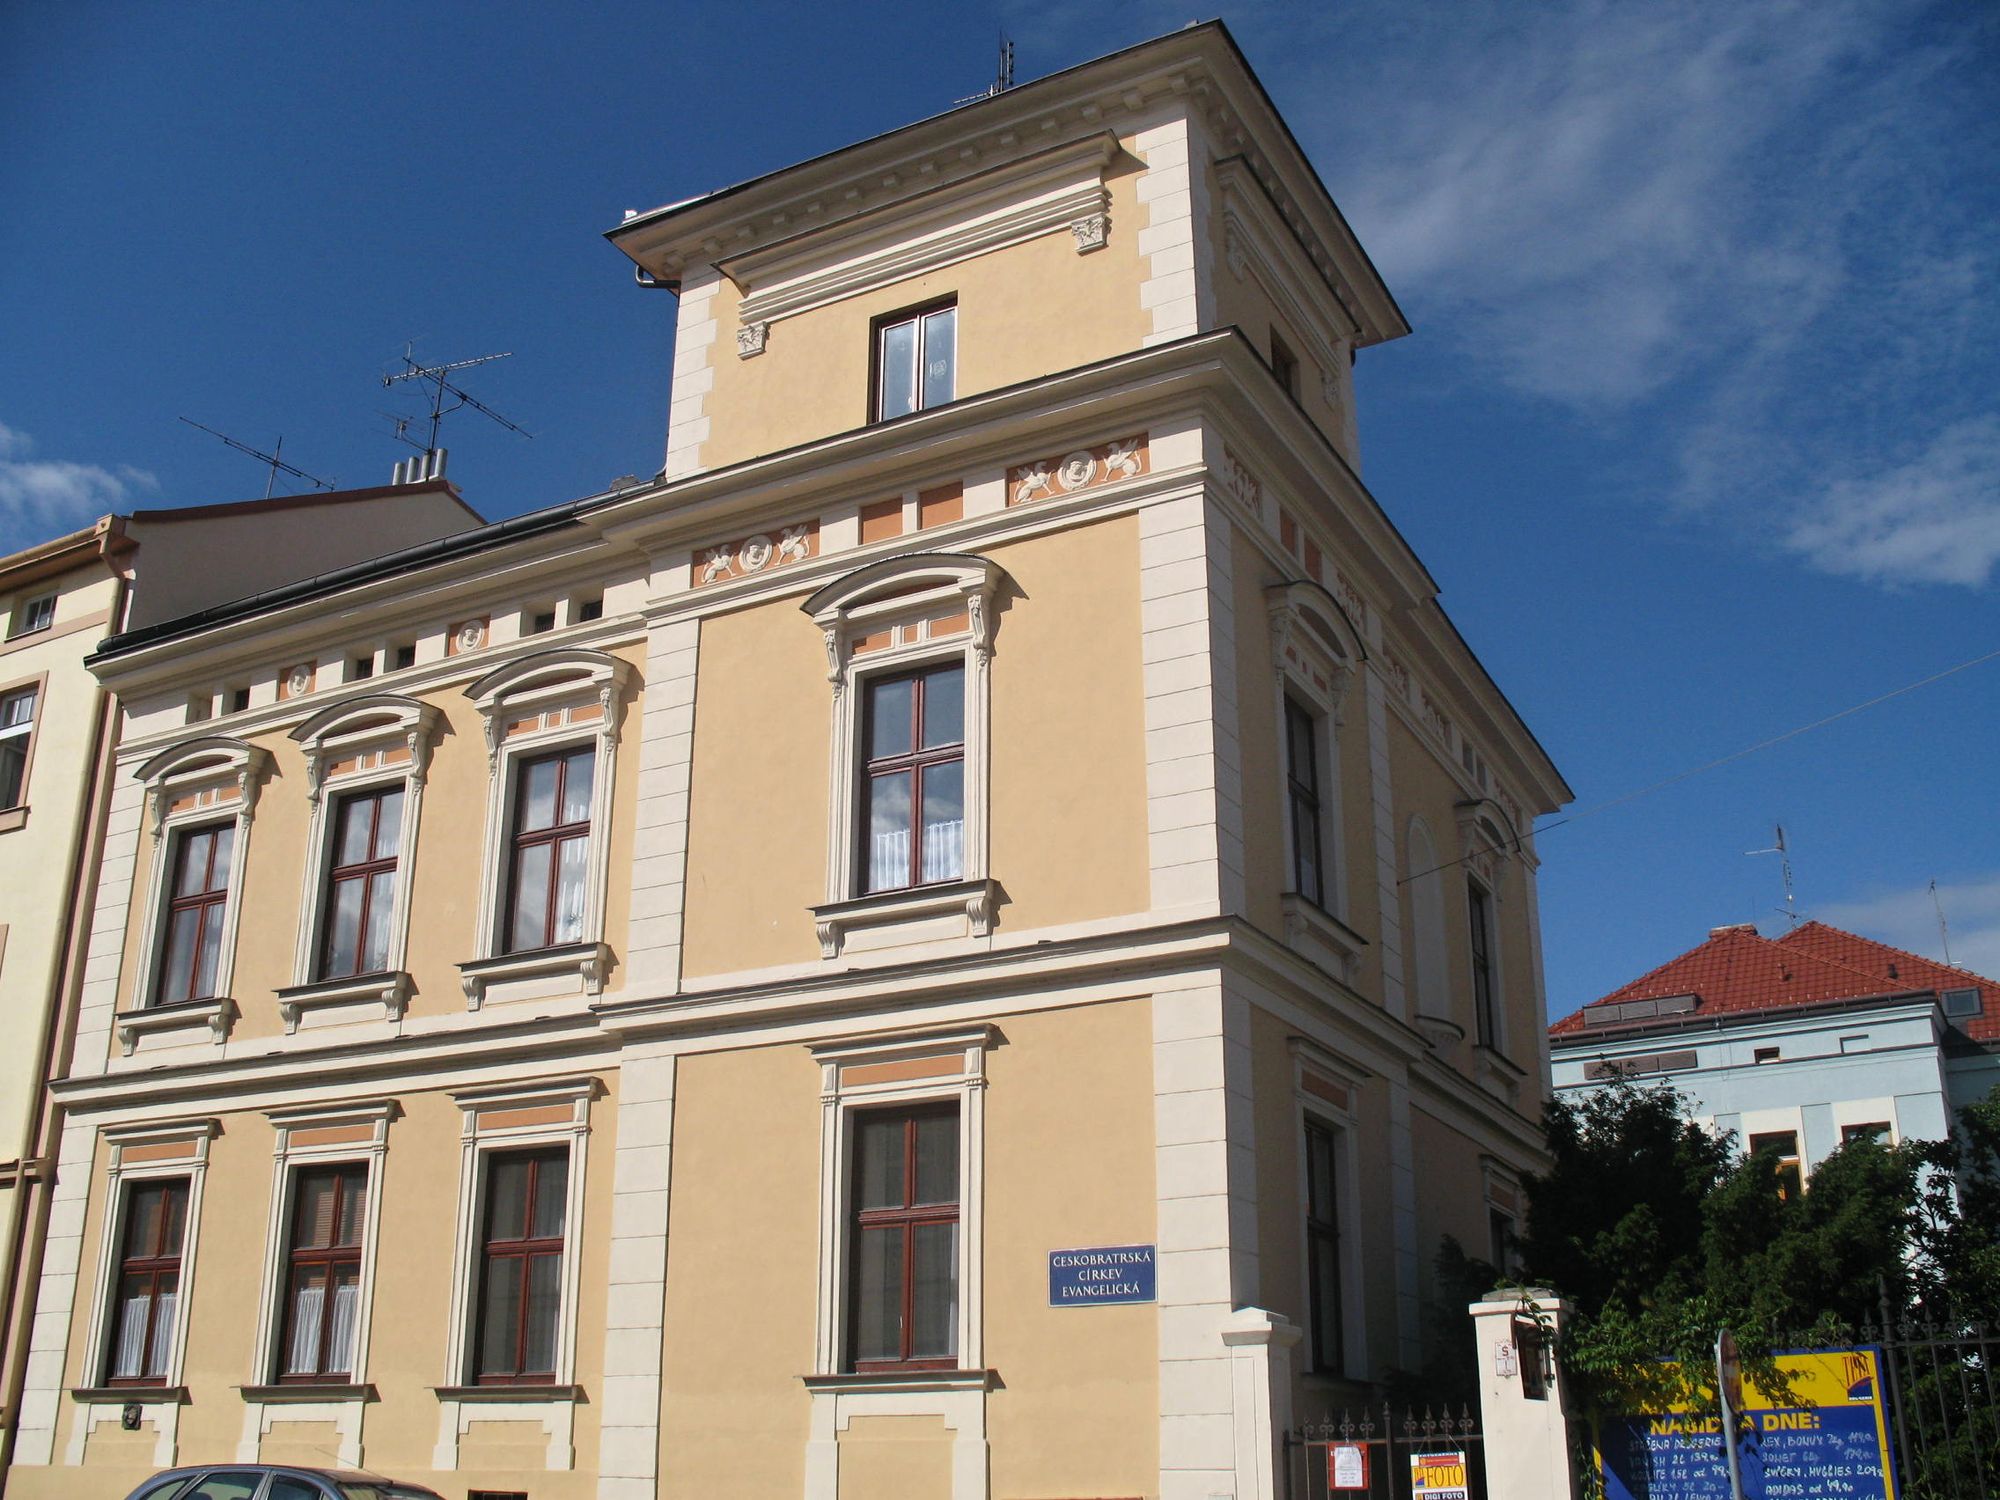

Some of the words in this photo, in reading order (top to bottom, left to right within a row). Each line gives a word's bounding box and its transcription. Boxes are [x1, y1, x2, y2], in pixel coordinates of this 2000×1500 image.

[1078, 1268, 1123, 1281] CÍRKEV
[1062, 1281, 1140, 1297] EVANGELICKÁ
[1763, 1412, 1821, 1431] DNE:
[1427, 1466, 1463, 1487] FOTO
